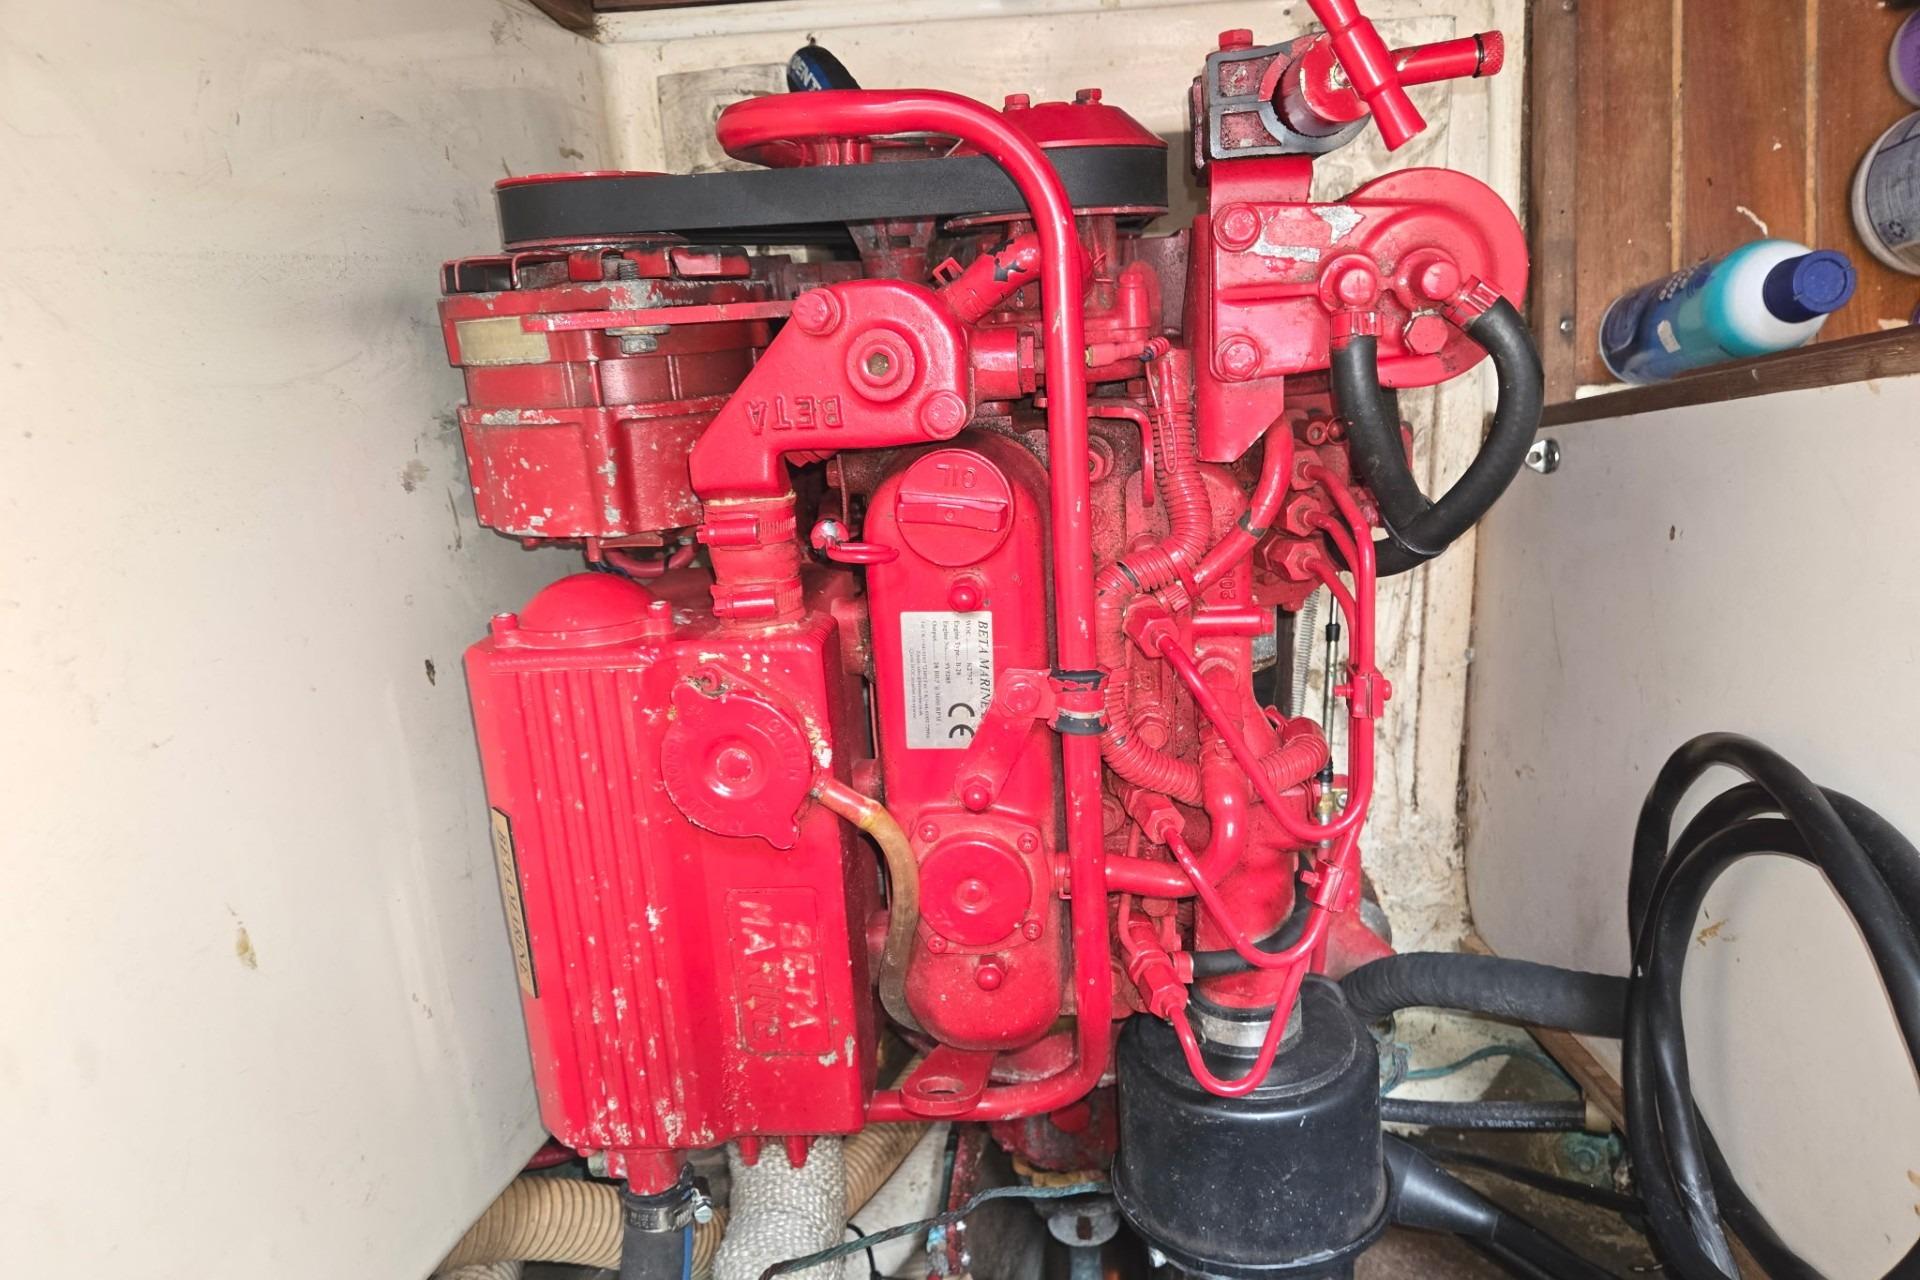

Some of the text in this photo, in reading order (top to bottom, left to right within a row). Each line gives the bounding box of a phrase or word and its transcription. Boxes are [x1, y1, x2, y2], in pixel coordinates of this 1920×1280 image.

[745, 395, 844, 436] BETA
[936, 464, 976, 489] OIL
[978, 621, 990, 653] BETA
[979, 658, 991, 709] MARINE
[738, 900, 782, 1043] MARINE
[779, 921, 822, 1030] BETA
